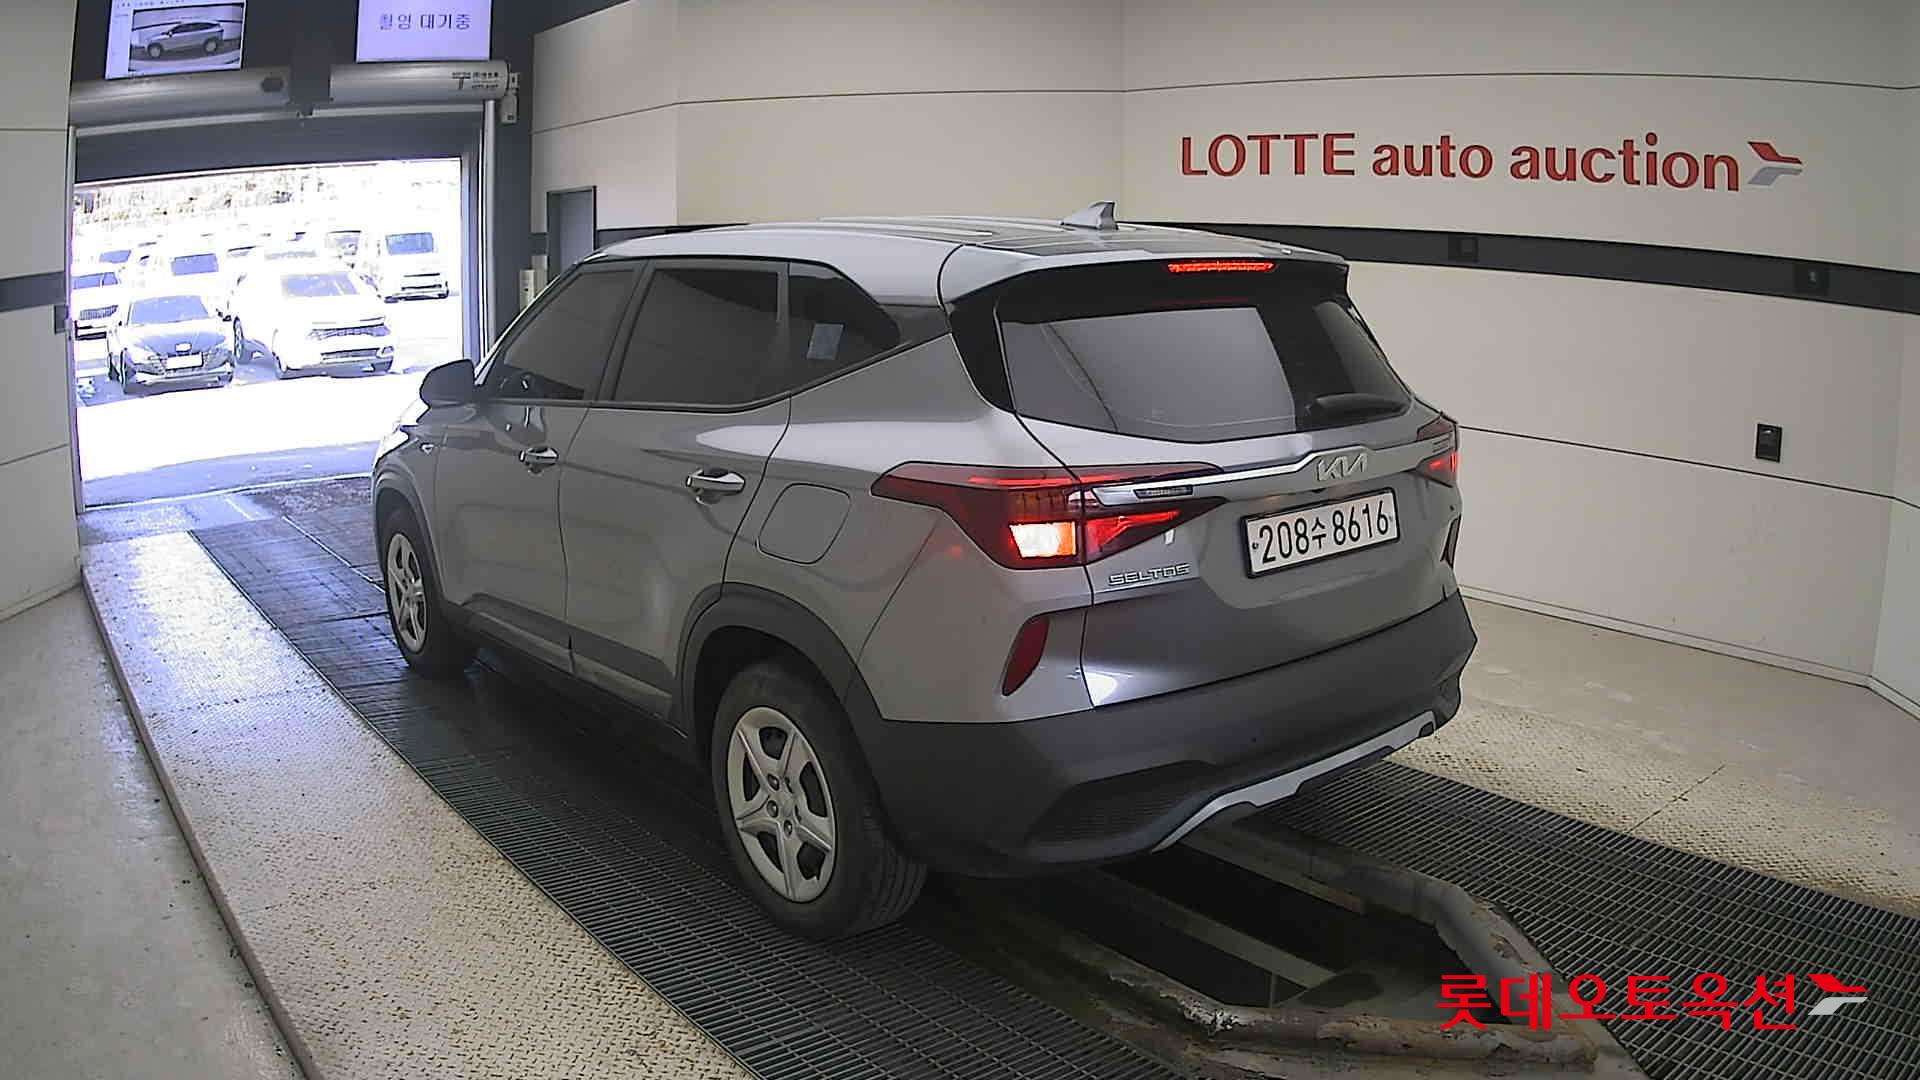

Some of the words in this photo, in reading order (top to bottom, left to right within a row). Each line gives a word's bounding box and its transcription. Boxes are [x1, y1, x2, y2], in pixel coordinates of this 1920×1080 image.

[420, 13, 471, 30] 대기중
[1182, 133, 1356, 177] LOTTE
[1372, 136, 1494, 178] auto
[1510, 131, 1740, 191] auction
[1108, 562, 1191, 586] SELTOS
